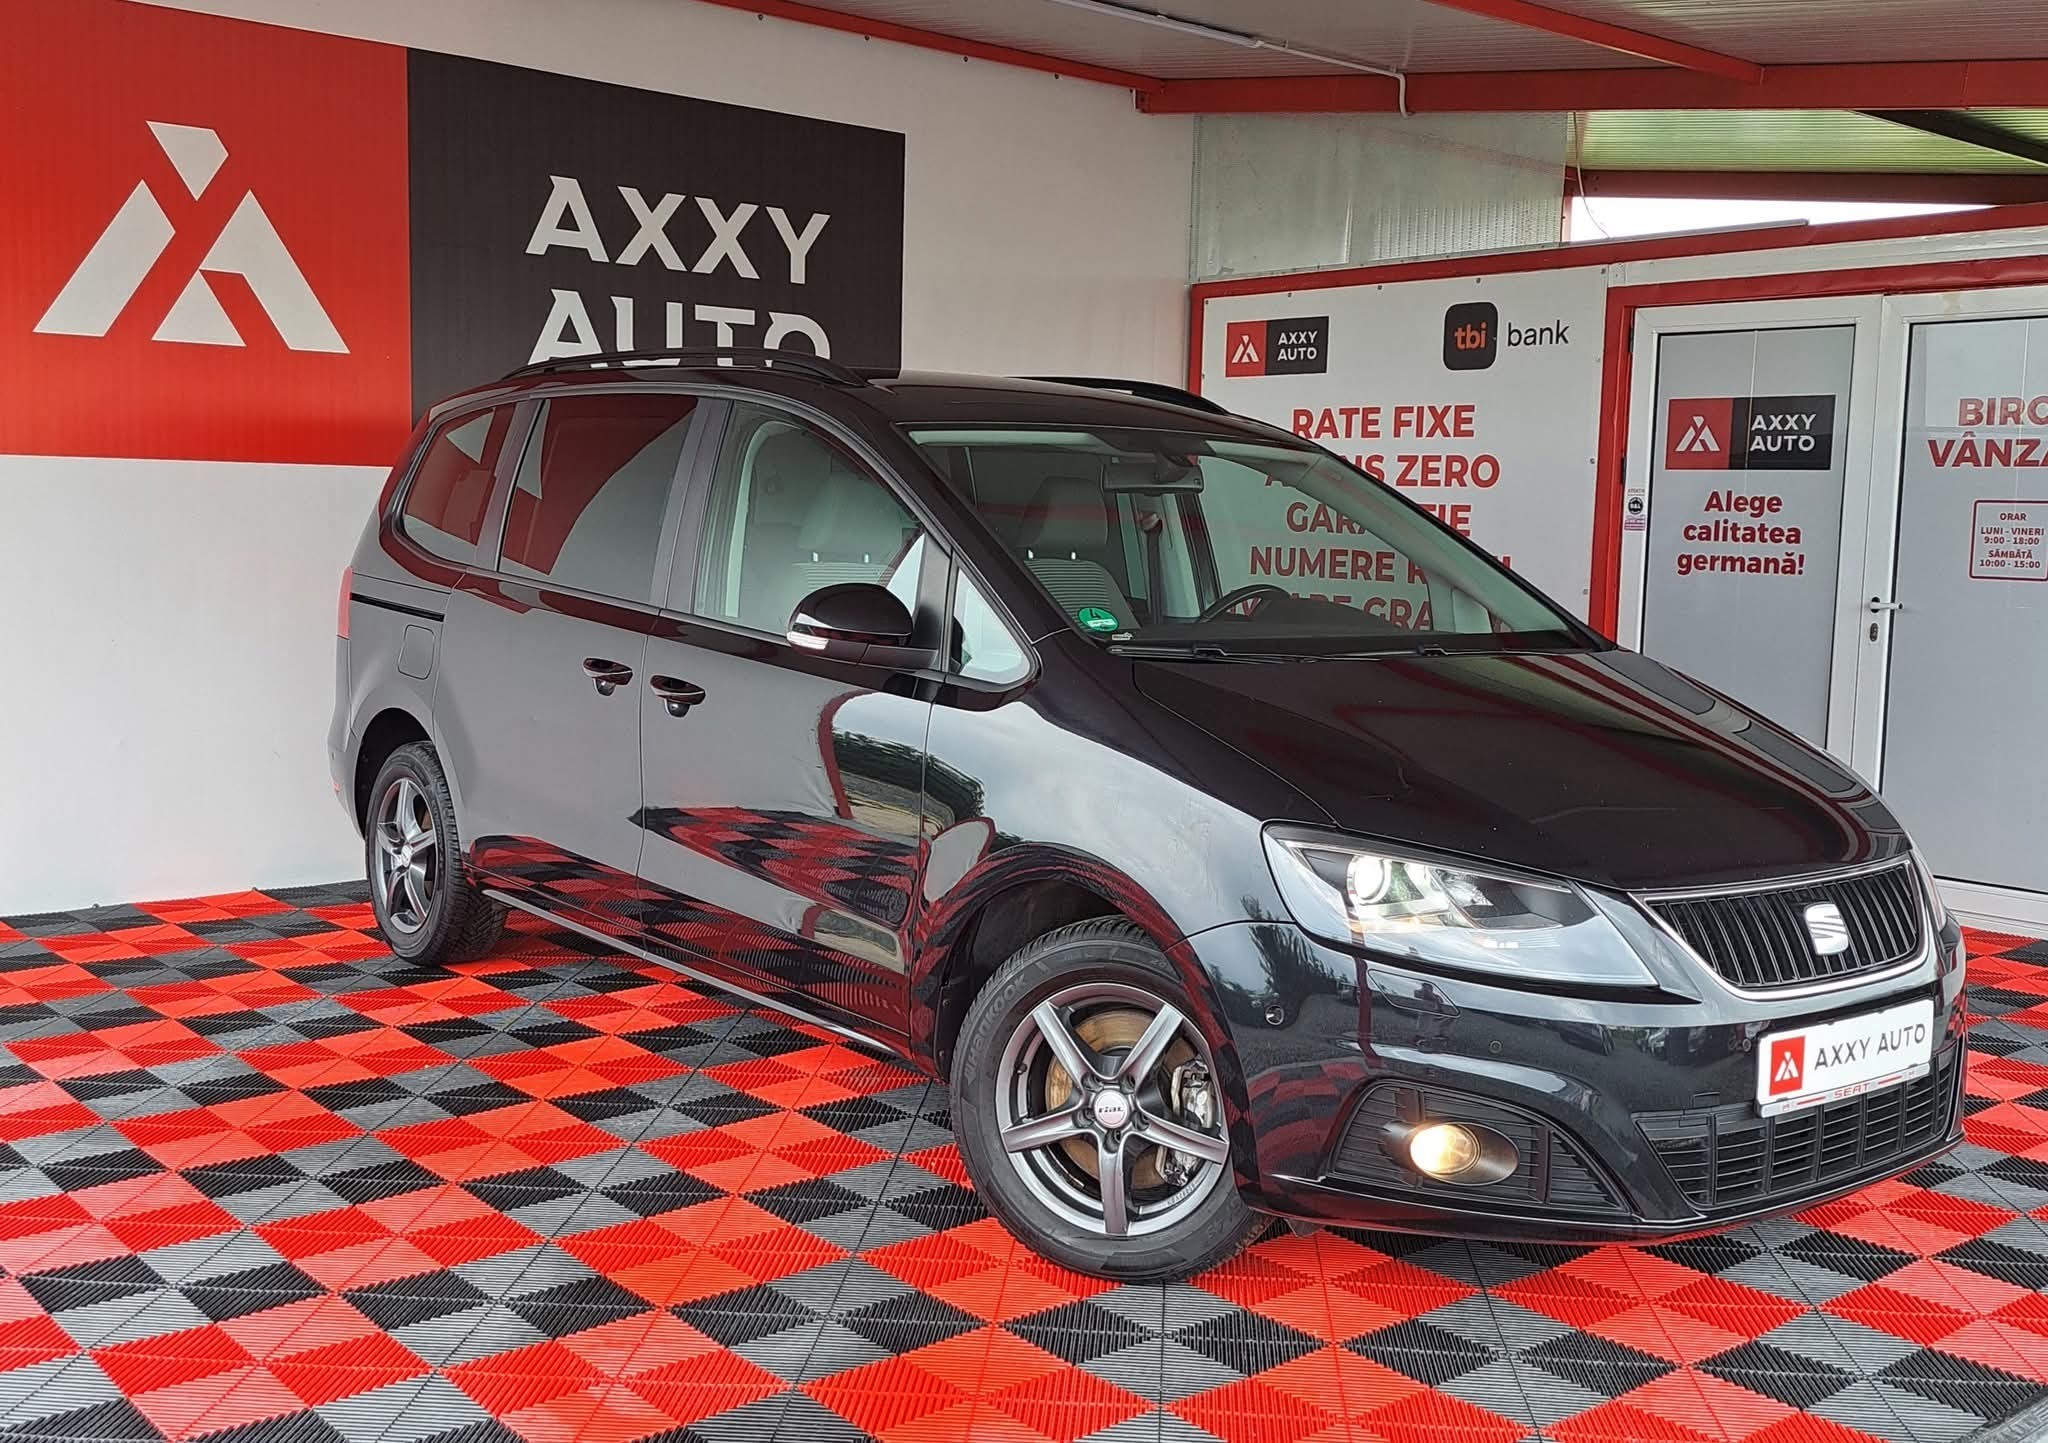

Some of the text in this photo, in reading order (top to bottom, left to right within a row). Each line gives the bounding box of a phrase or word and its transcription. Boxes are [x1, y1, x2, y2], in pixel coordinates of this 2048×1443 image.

[525, 175, 832, 285] AXXY
[527, 288, 832, 368] AUTO
[1277, 330, 1319, 346] AXXY
[1454, 320, 1570, 350] tbi bank
[1276, 347, 1318, 362] AUTO
[1292, 405, 1475, 439] RATE FIXE
[1750, 413, 1817, 431] AXXY
[1749, 435, 1816, 452] AUTO
[1928, 431, 2048, 467] VÂNZ
[1396, 454, 1501, 488] ZERO
[1704, 490, 1783, 518] Alege
[2000, 512, 2027, 521] ORAR
[1683, 519, 1802, 545] calitatea
[1981, 527, 2004, 535] LUNI
[2011, 527, 2045, 536] VINERI
[1984, 536, 2005, 544] 9:00
[2013, 537, 2040, 545] 18:00
[1250, 546, 1396, 583] NUMERE
[1677, 552, 1805, 576] germană!
[1980, 559, 2006, 567] 10:00
[2014, 560, 2041, 568] 15:00
[1089, 608, 1102, 619] 4
[1814, 1023, 1926, 1070] AXXY AUTO
[1833, 1083, 1870, 1098] SEAT
